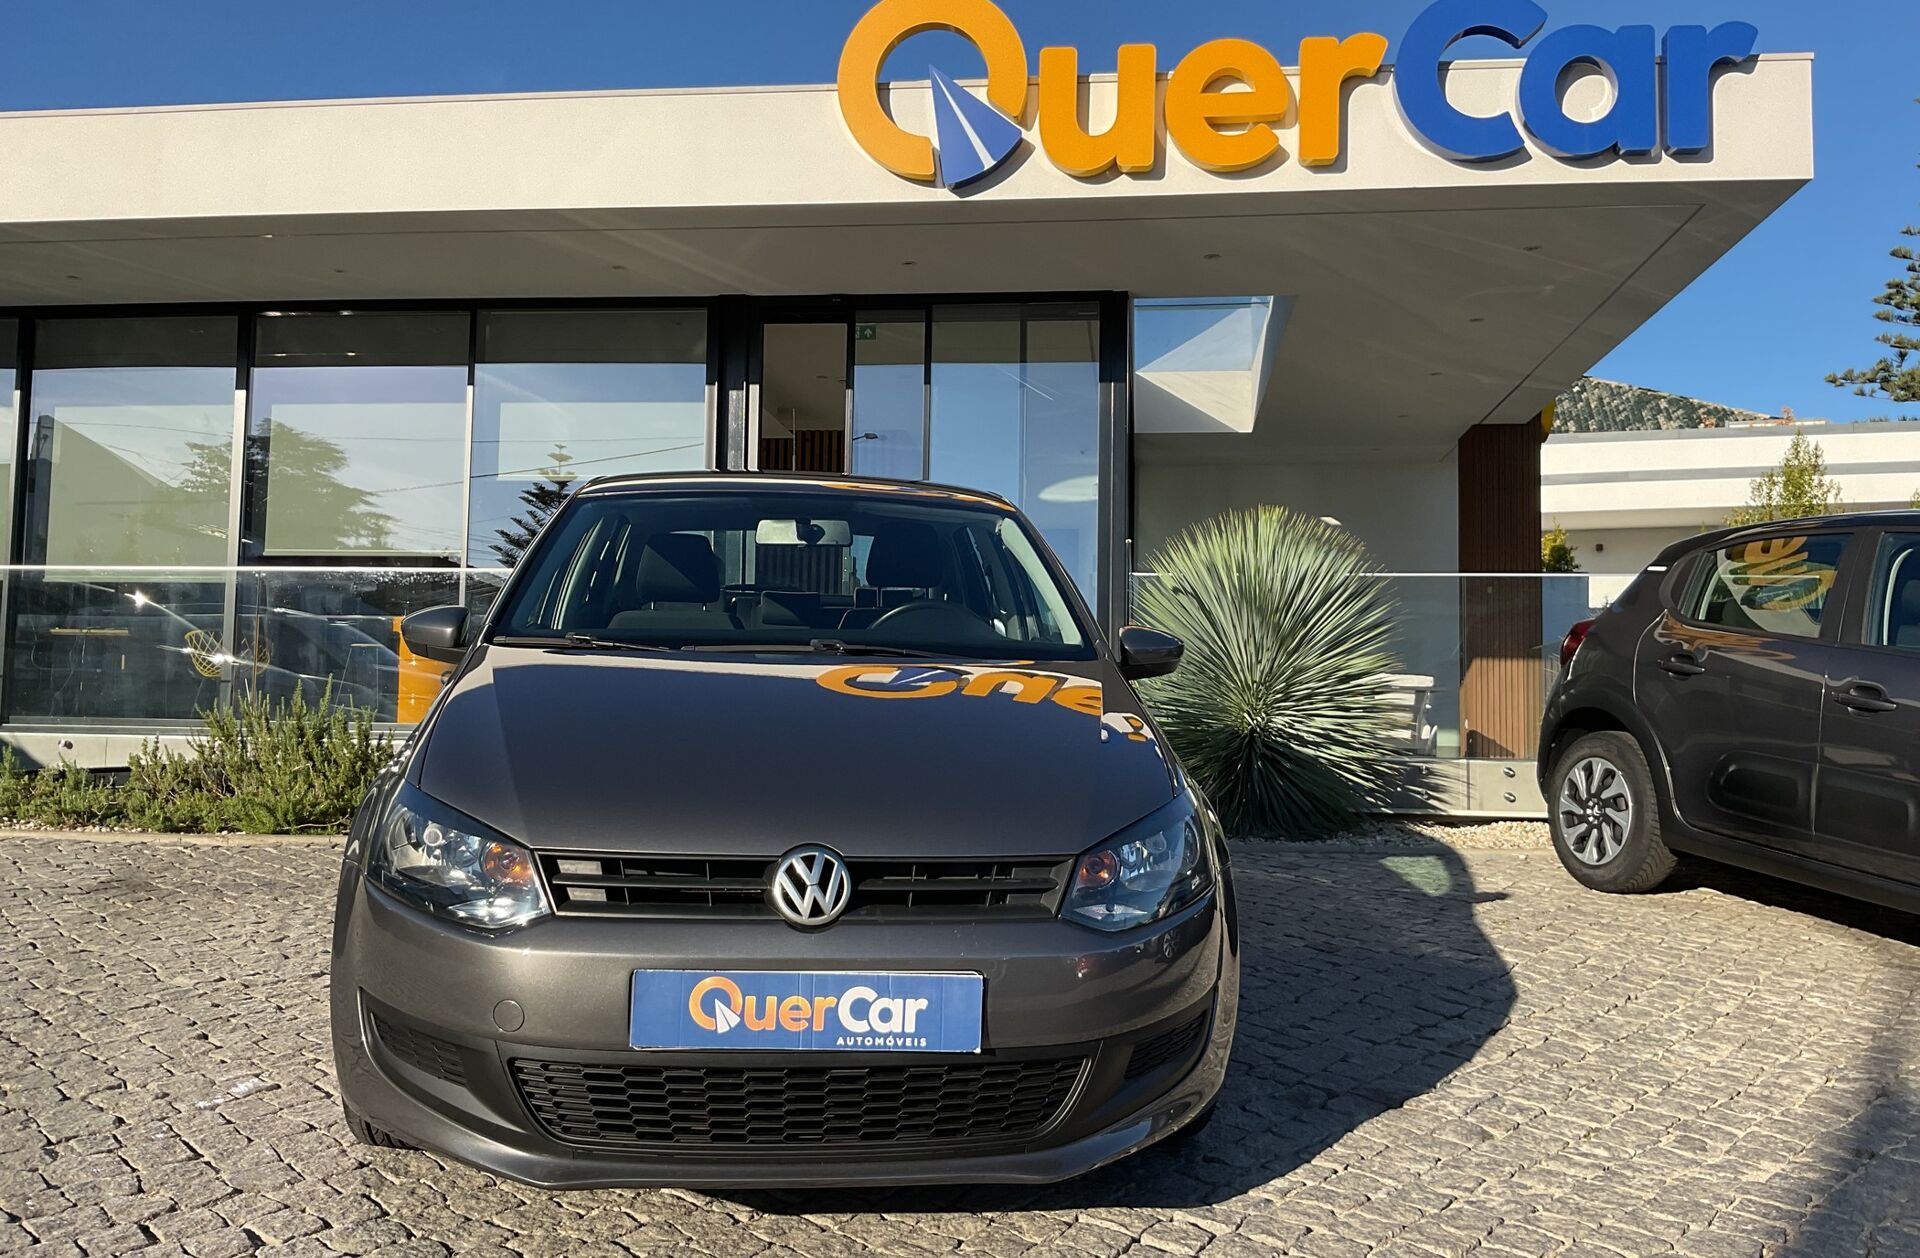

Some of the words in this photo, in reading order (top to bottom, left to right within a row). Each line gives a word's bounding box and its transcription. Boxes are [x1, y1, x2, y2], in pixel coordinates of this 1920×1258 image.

[837, 0, 1759, 190] QuerCar
[688, 976, 929, 1034] QuerCar
[836, 1035, 928, 1047] AUTOMÓVEIS
